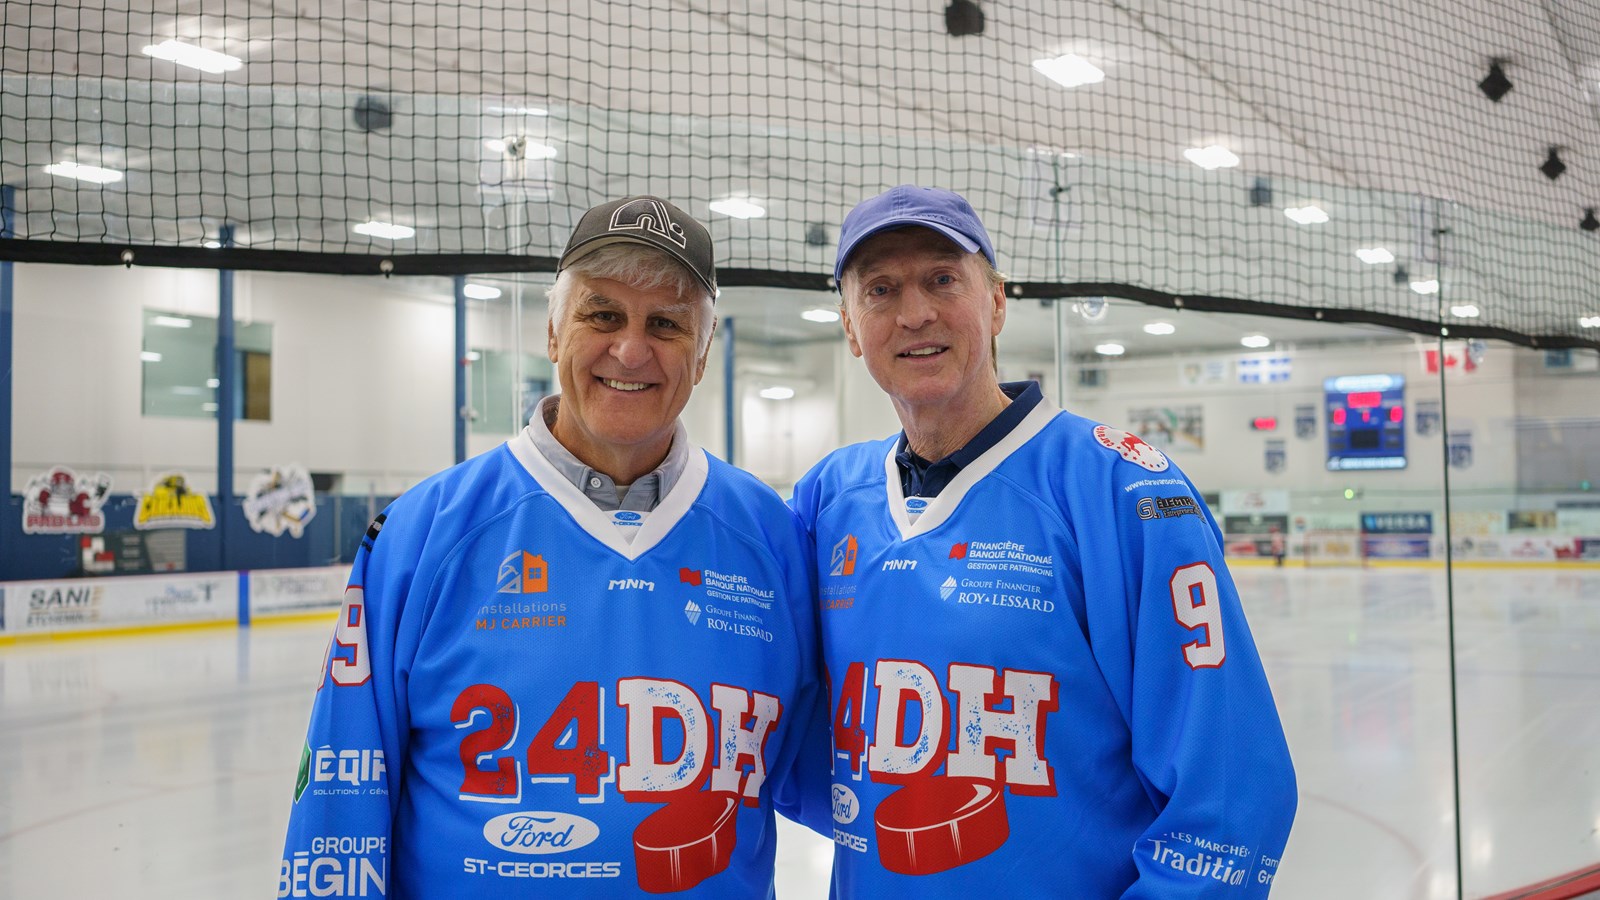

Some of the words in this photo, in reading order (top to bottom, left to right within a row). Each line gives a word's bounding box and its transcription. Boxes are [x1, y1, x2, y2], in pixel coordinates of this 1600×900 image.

[969, 550, 1006, 559] BANQUE
[970, 541, 1025, 552] FINANCIÈRE
[882, 559, 918, 572] MNM
[967, 562, 998, 570] GESTION
[999, 563, 1008, 571] DE
[608, 579, 655, 592] MNM
[704, 569, 748, 585] FINANCIÈRE
[705, 578, 735, 591] BANQUE
[736, 584, 775, 599] NATIONALE
[706, 589, 732, 601] GESTION
[732, 595, 740, 603] DE
[477, 602, 567, 616] installations
[958, 592, 986, 605] ROY
[991, 594, 1055, 613] LESSARD
[476, 618, 496, 631] MJ
[501, 615, 567, 630] CARRIER
[1169, 561, 1226, 671] 9
[318, 584, 372, 690] 9
[707, 617, 729, 632] ROY
[733, 623, 773, 642] LESSARD
[825, 658, 1060, 798] 4DH
[450, 677, 783, 807] 24DH
[313, 788, 360, 796] SOLUTIONS
[832, 787, 852, 819] Ford
[501, 815, 575, 848] Ford
[1171, 831, 1193, 843] LES
[311, 836, 387, 855] GROUPE
[463, 857, 621, 879] ST-GEORGES
[1147, 838, 1246, 886] Tradition
[1260, 854, 1280, 868] Fam
